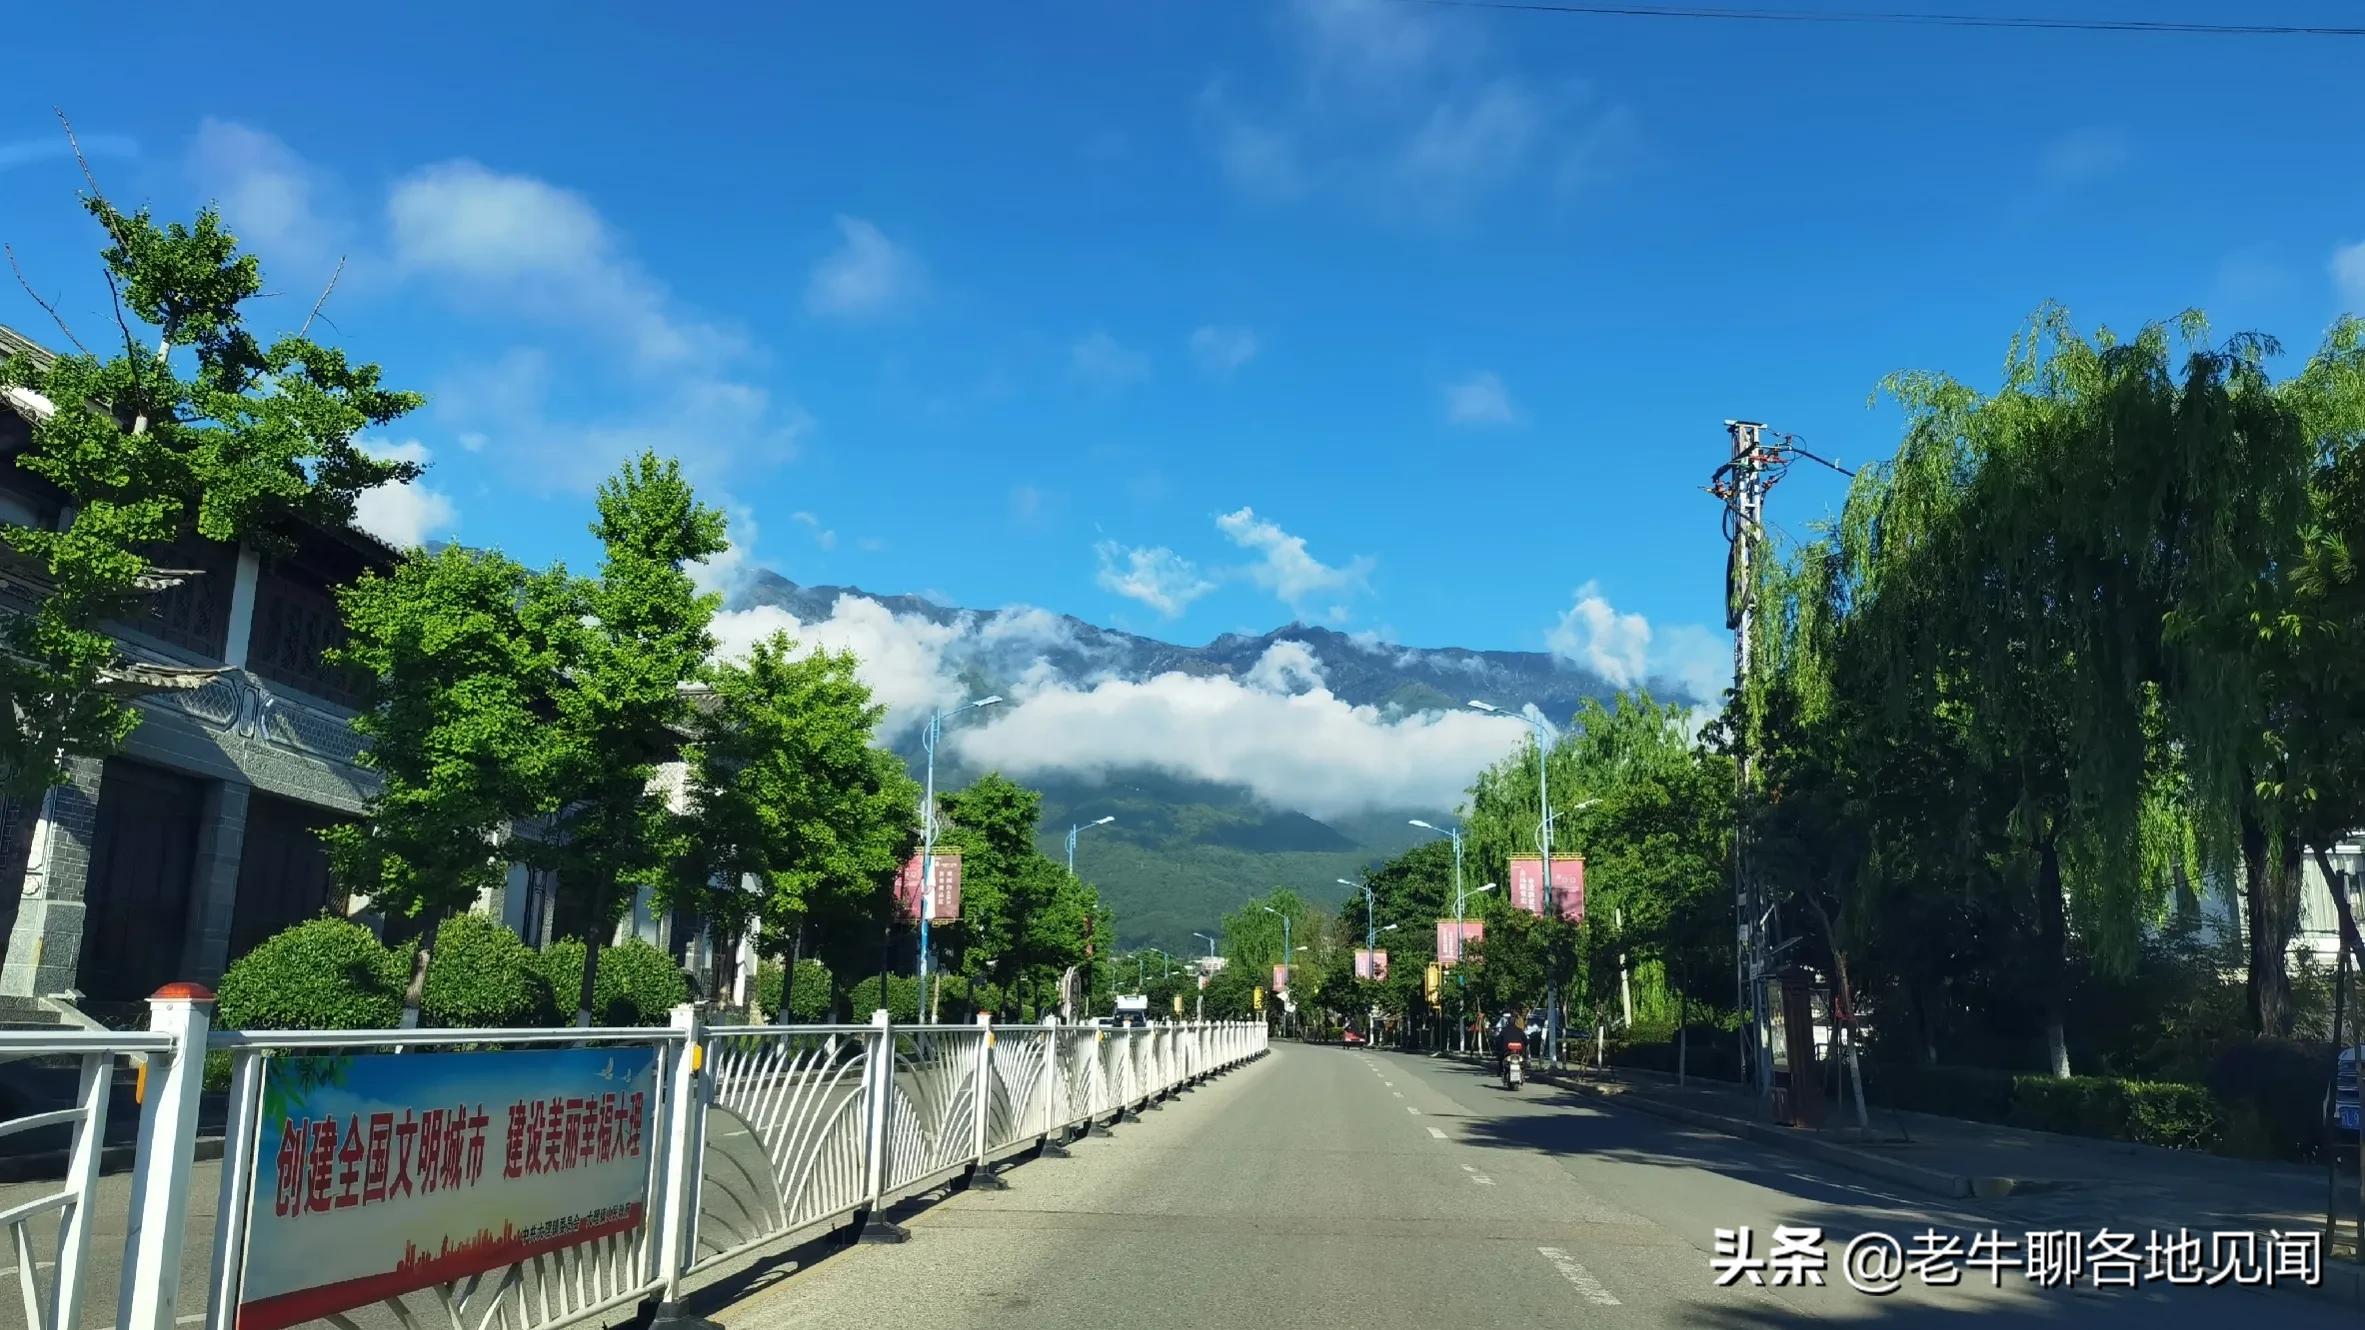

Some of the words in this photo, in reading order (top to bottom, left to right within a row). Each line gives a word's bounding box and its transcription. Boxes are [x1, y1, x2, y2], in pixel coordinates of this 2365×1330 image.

[276, 1103, 489, 1217] 创建全国文明城市
[503, 1090, 644, 1180] 建设美丽幸福大理
